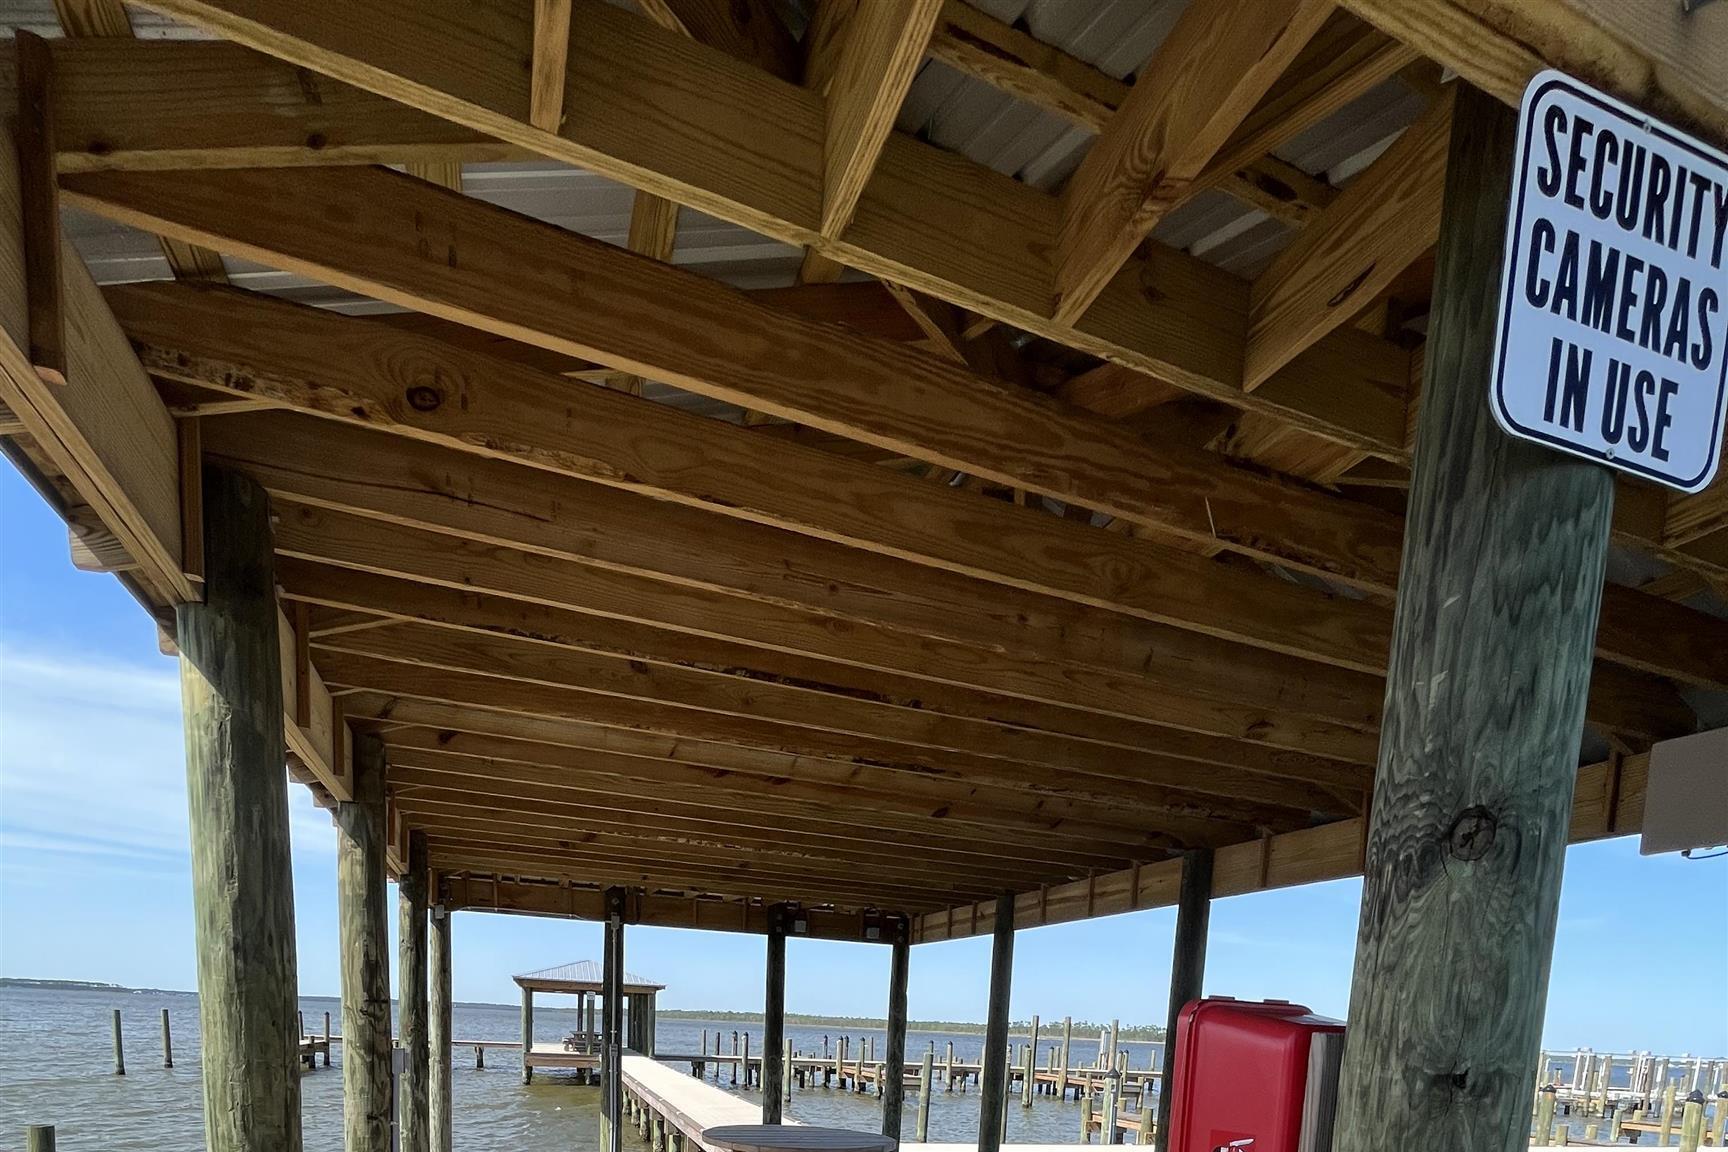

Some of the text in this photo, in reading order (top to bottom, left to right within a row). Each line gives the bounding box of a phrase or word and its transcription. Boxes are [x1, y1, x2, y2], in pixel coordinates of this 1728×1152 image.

[1537, 104, 1728, 269] SECURITY
[1525, 218, 1718, 371] CAMERAS
[1543, 337, 1679, 462] IN USE
